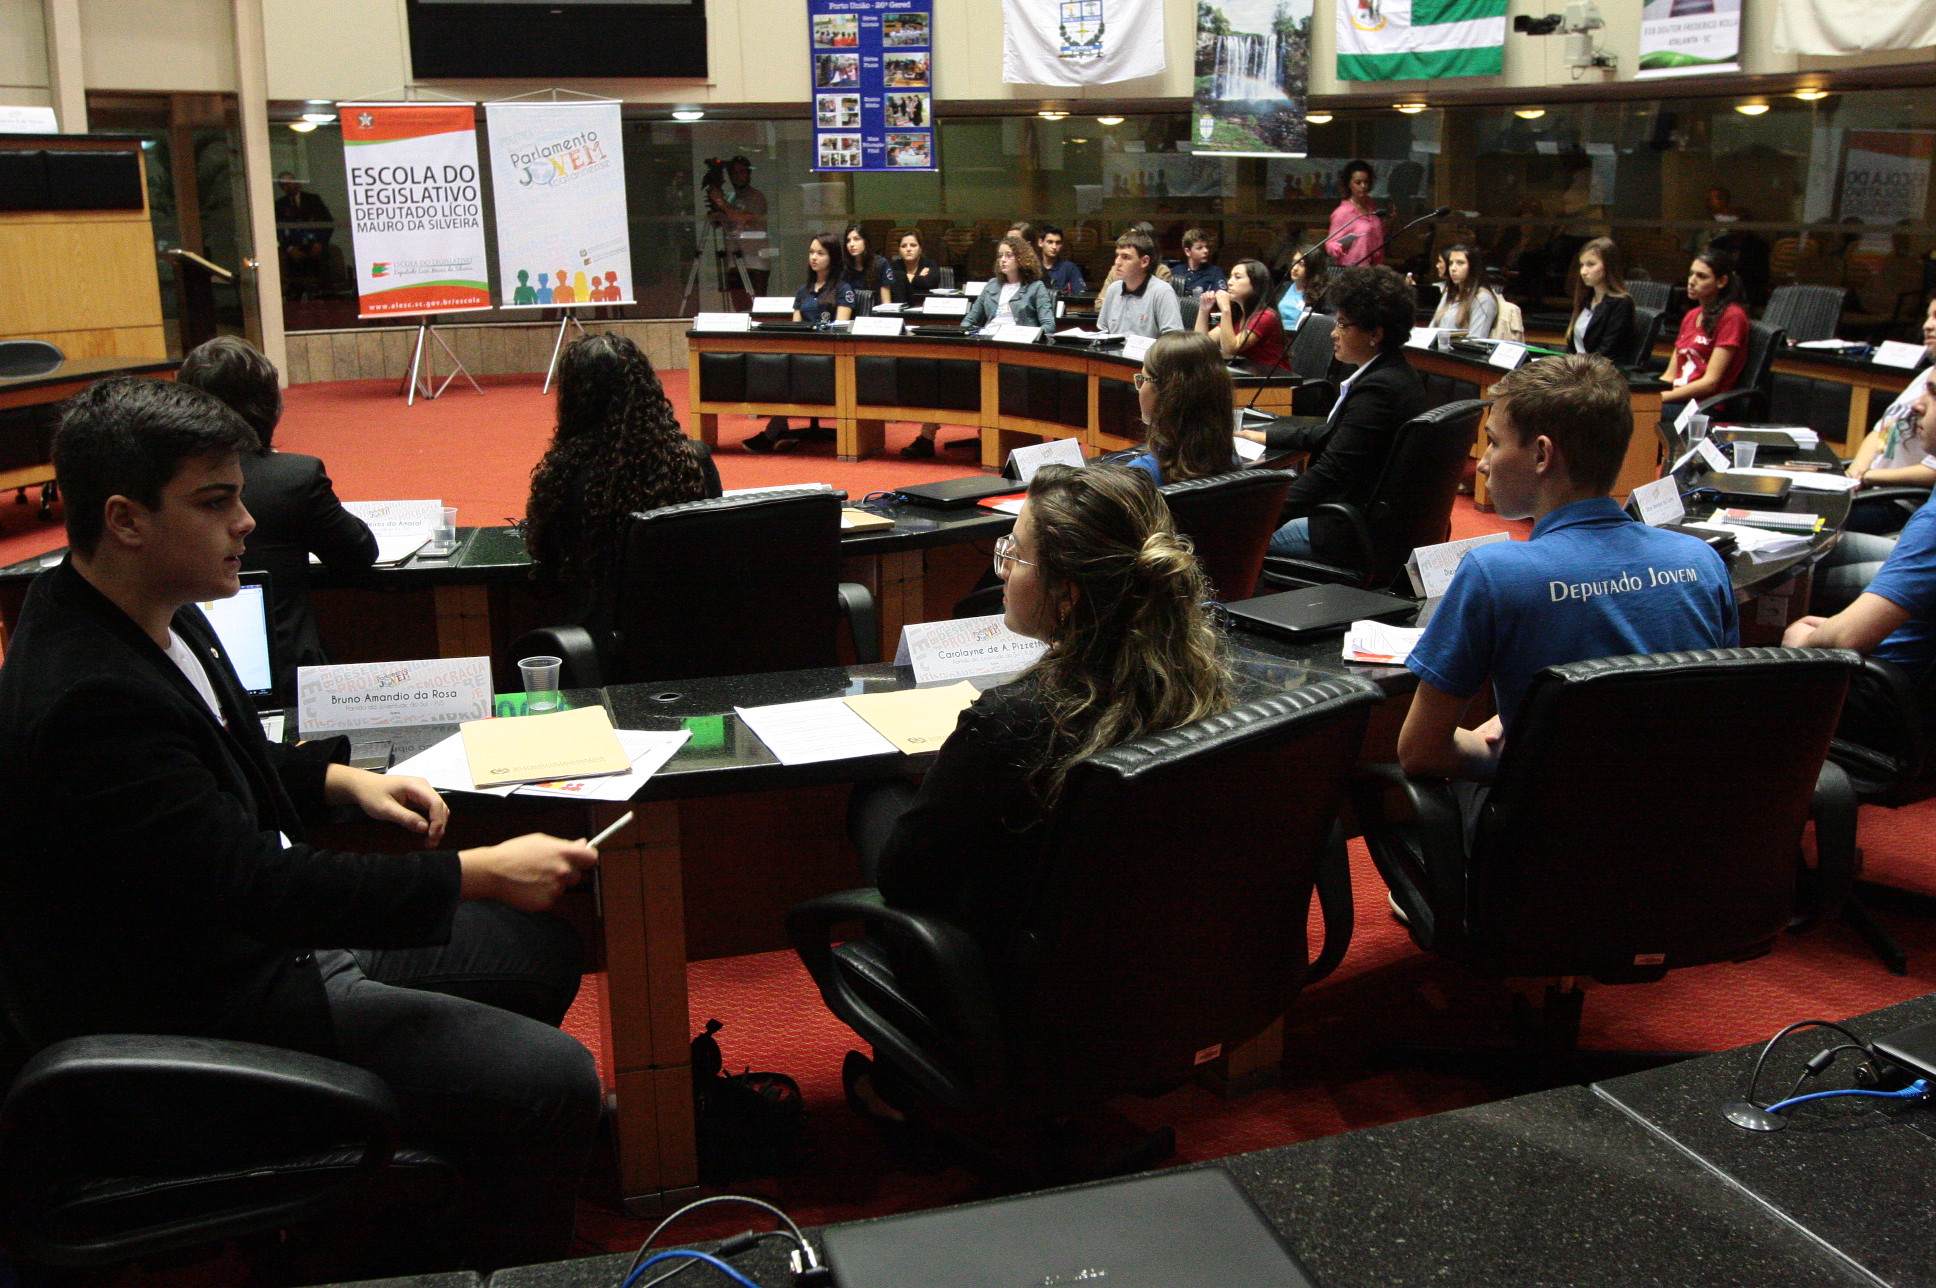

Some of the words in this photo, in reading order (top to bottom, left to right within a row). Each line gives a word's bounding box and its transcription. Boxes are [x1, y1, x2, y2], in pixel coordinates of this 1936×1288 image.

[510, 131, 598, 168] Parlamento
[351, 166, 437, 186] ESCOLA
[443, 164, 475, 184] DO
[353, 185, 477, 206] LEGISLATIVO
[355, 205, 438, 221] DEPUTADO
[441, 202, 479, 218] LÍCIO
[357, 220, 405, 233] MAURO
[407, 219, 425, 231] DA
[428, 217, 480, 230] SILVEIRA
[368, 297, 481, 311] www.alesc.sc.gov.br/escola
[938, 648, 985, 661] Carolayne
[987, 643, 999, 654] de
[331, 694, 361, 705] Bruno
[364, 691, 410, 703] Amandio
[413, 690, 429, 700] da
[432, 689, 458, 699] Rosa
